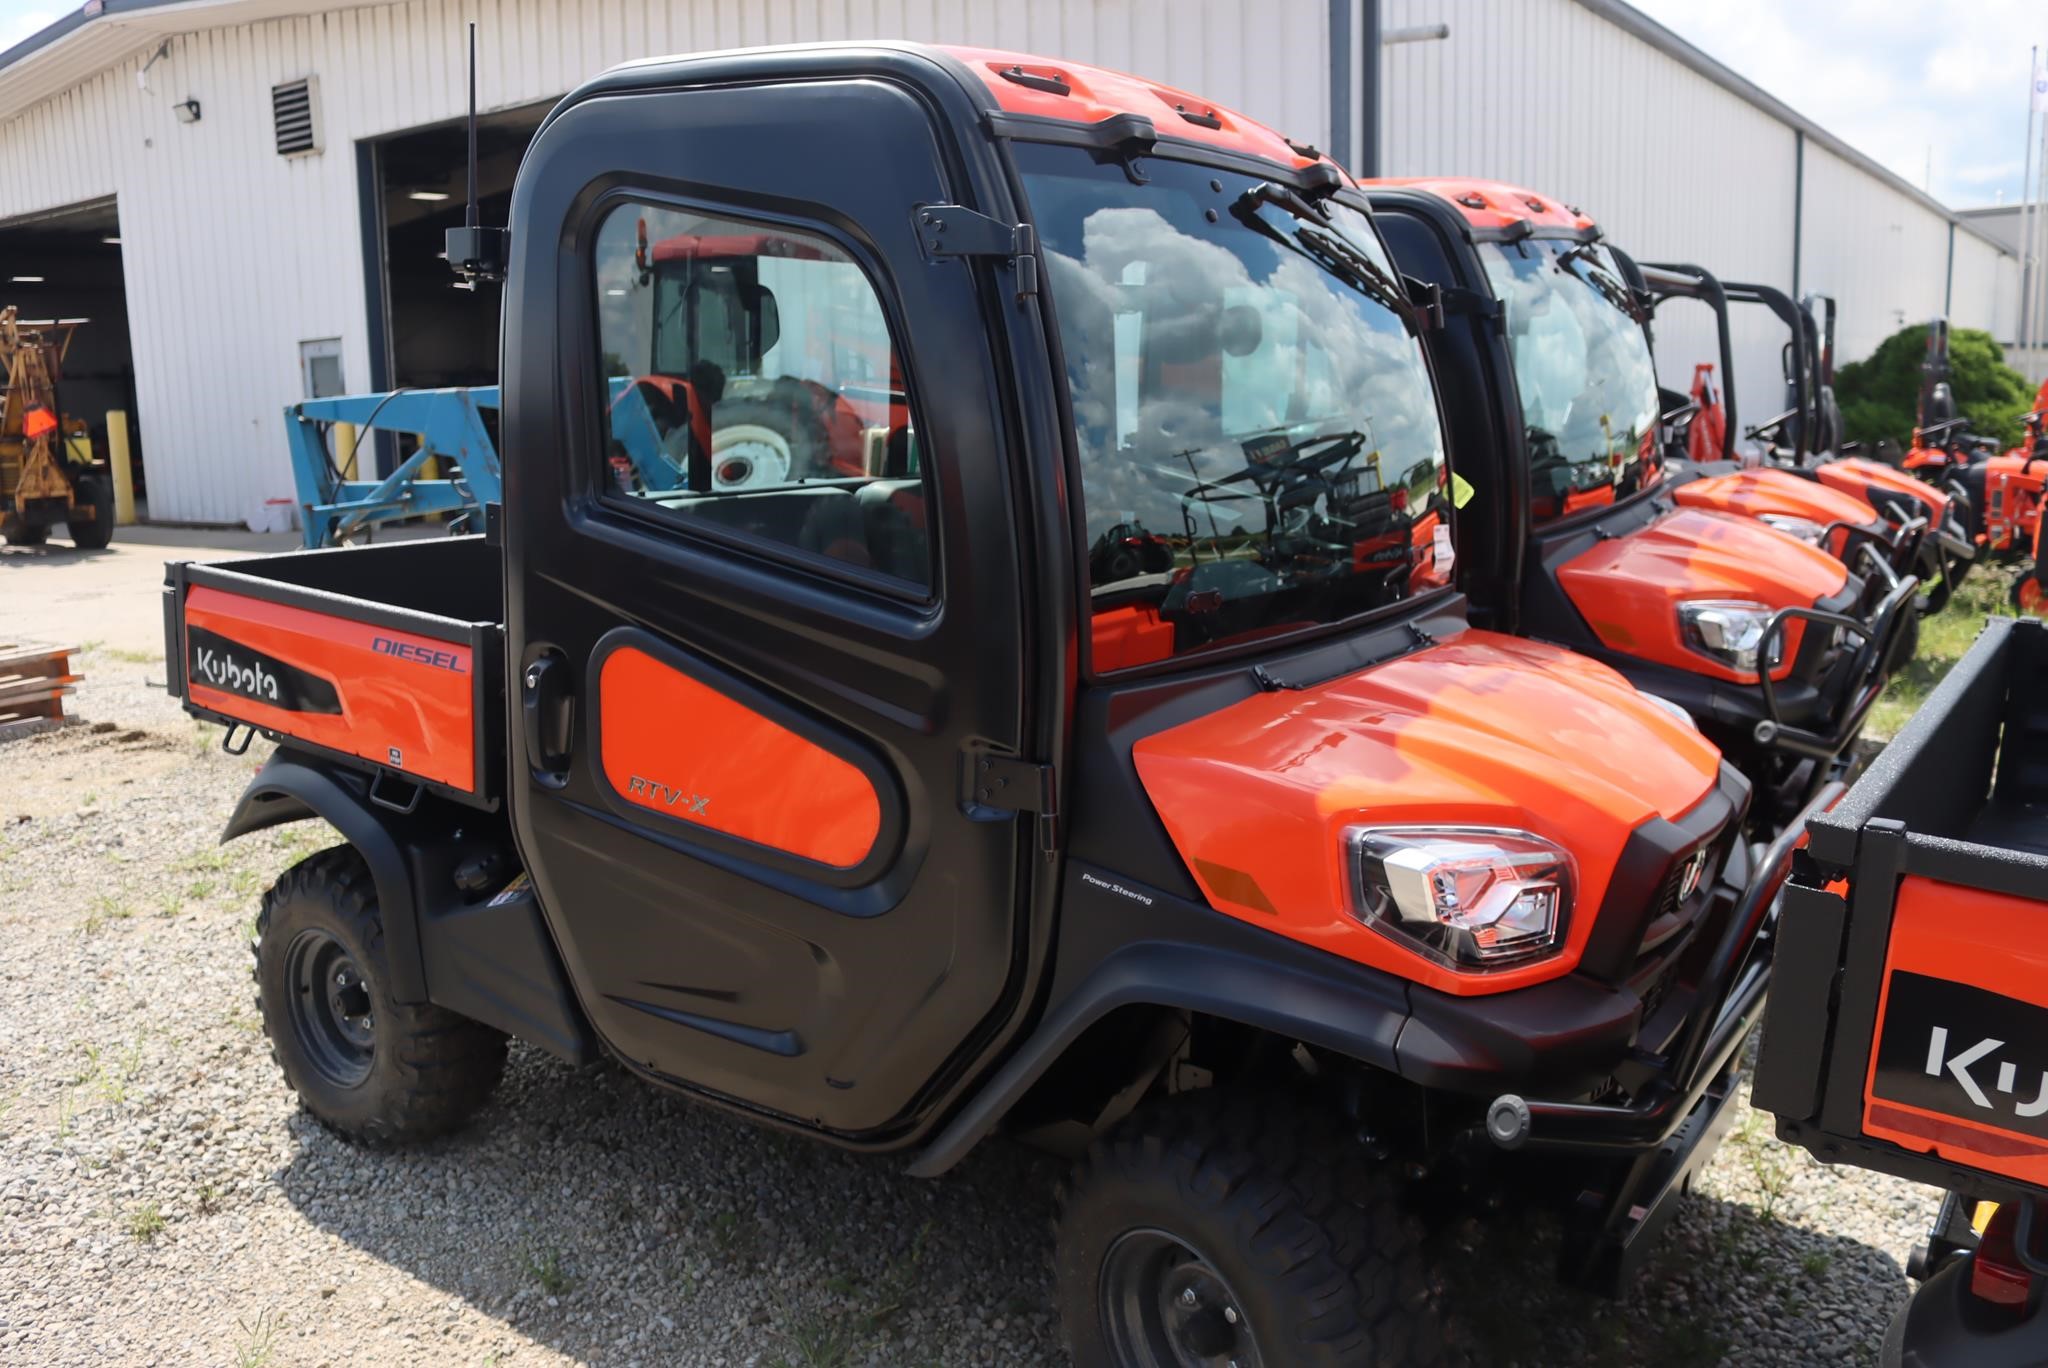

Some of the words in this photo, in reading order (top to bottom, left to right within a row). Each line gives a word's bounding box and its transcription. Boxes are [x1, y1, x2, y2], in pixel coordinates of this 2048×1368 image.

[197, 646, 278, 701] Kubota
[372, 637, 466, 673] DIESEL
[628, 775, 710, 816] RTV-X
[1082, 873, 1112, 889] Power
[1112, 884, 1153, 906] Steering
